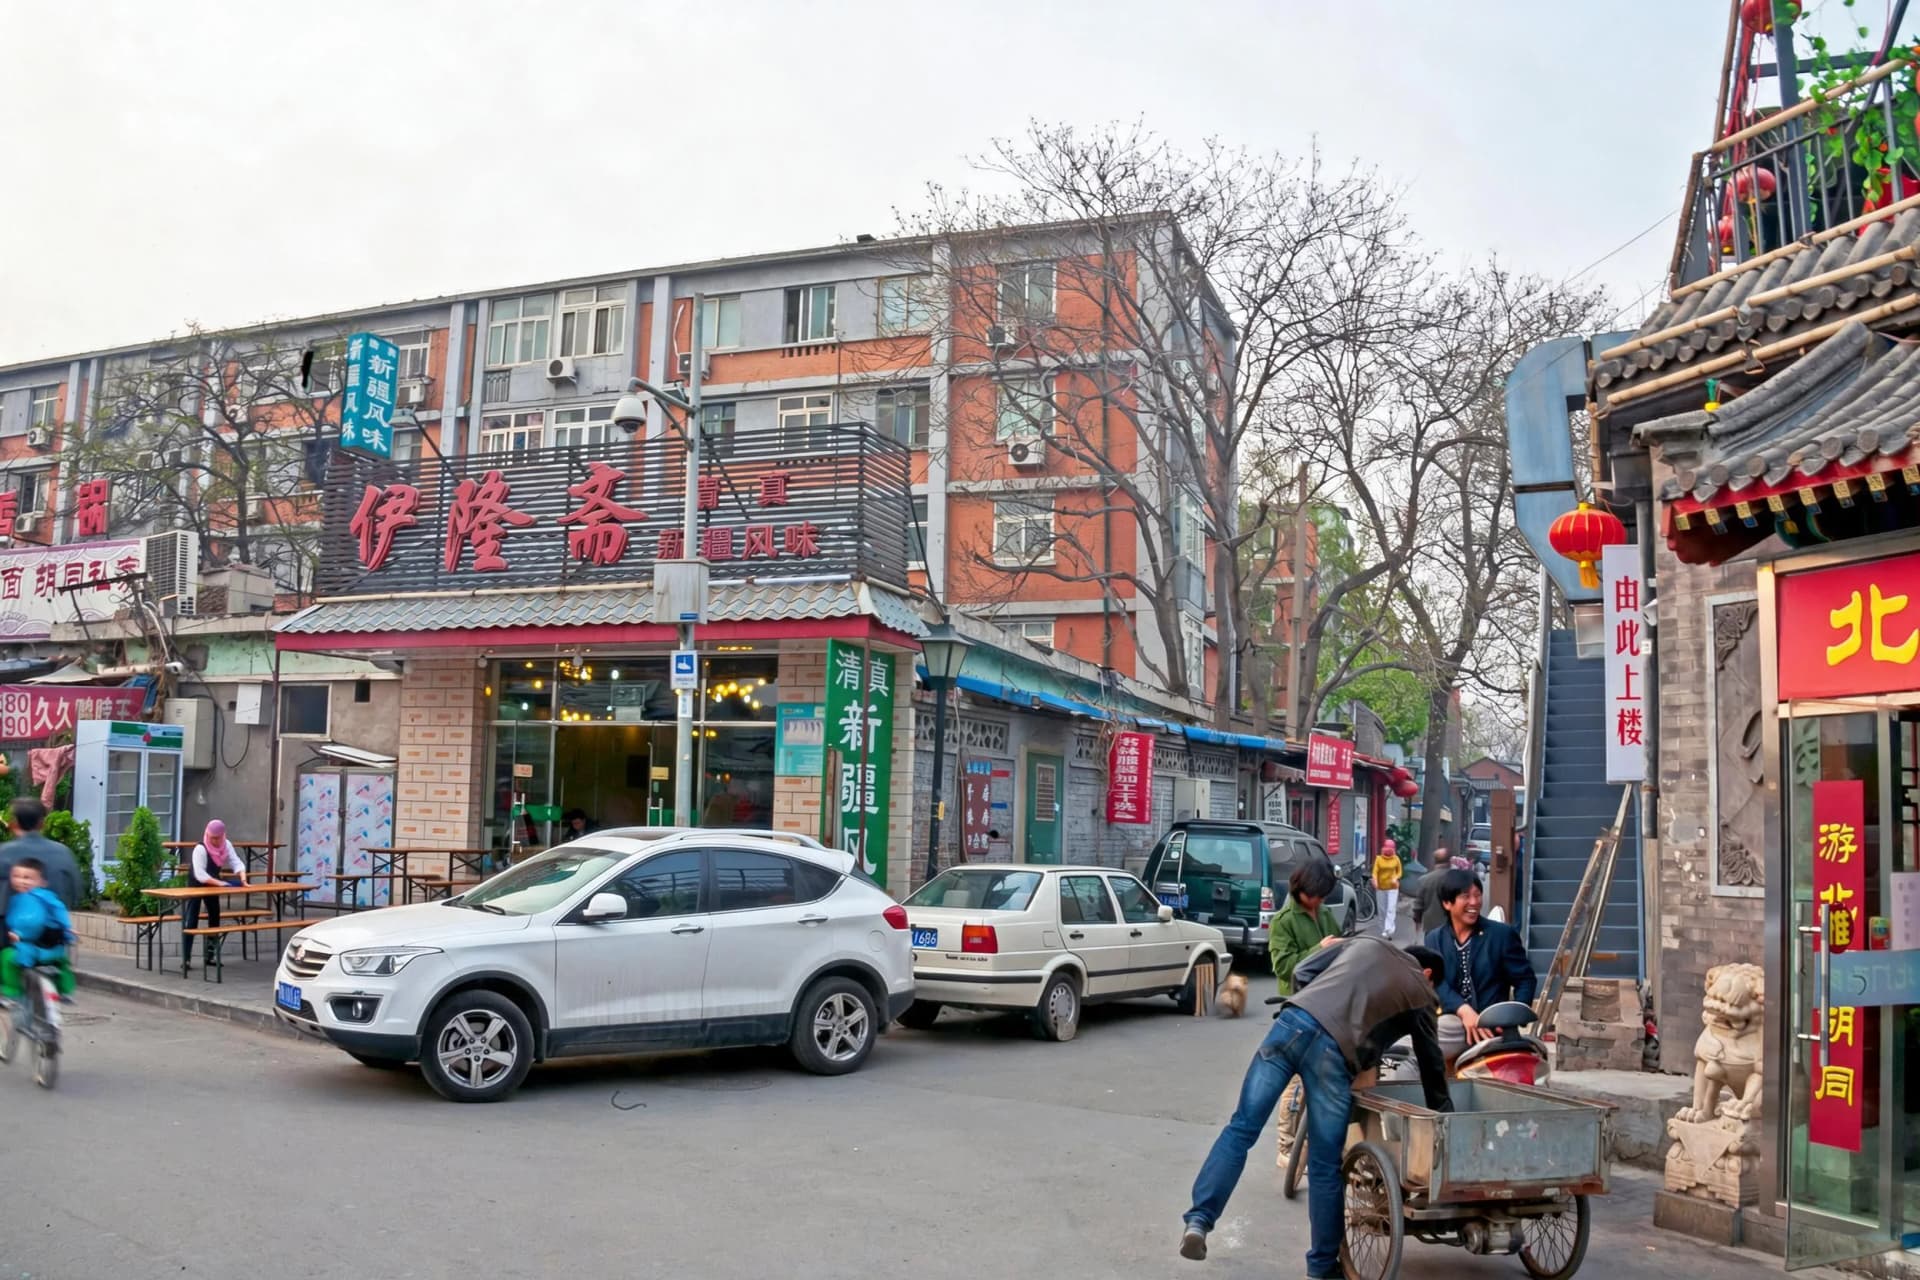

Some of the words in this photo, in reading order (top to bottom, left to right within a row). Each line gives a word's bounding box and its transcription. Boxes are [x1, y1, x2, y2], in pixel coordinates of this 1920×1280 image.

[362, 354, 395, 452] 新疆风味
[350, 462, 649, 574] 伊隆斋
[657, 520, 821, 561] 新疆风味
[1825, 583, 1920, 667] 北
[835, 648, 890, 698] 清真
[1615, 575, 1643, 747] 由此上楼
[5, 693, 29, 713] 80
[5, 717, 29, 736] 90
